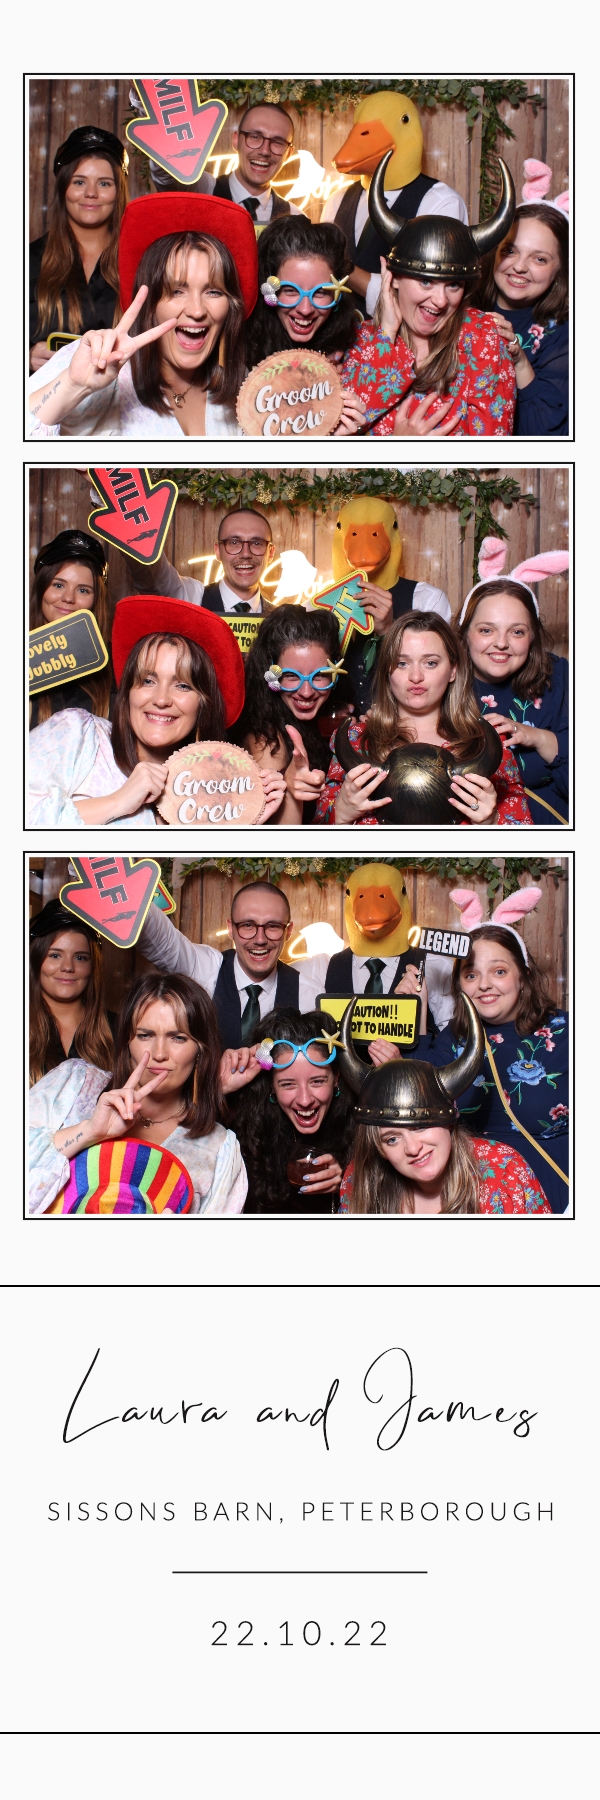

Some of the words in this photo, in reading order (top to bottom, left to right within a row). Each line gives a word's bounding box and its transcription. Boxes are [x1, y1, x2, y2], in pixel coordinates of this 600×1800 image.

[153, 79, 194, 141] MILF
[255, 380, 333, 413] Groom
[263, 409, 328, 436] Crew
[105, 468, 150, 525] MILF
[174, 770, 255, 796] Groom
[178, 798, 247, 824] Crew
[88, 857, 129, 905] ILF
[419, 929, 470, 957] LEGEND
[353, 1004, 398, 1020] AUTION!!
[351, 1021, 363, 1033] OT
[364, 1021, 377, 1034] TO
[378, 1022, 414, 1038] HANDLE
